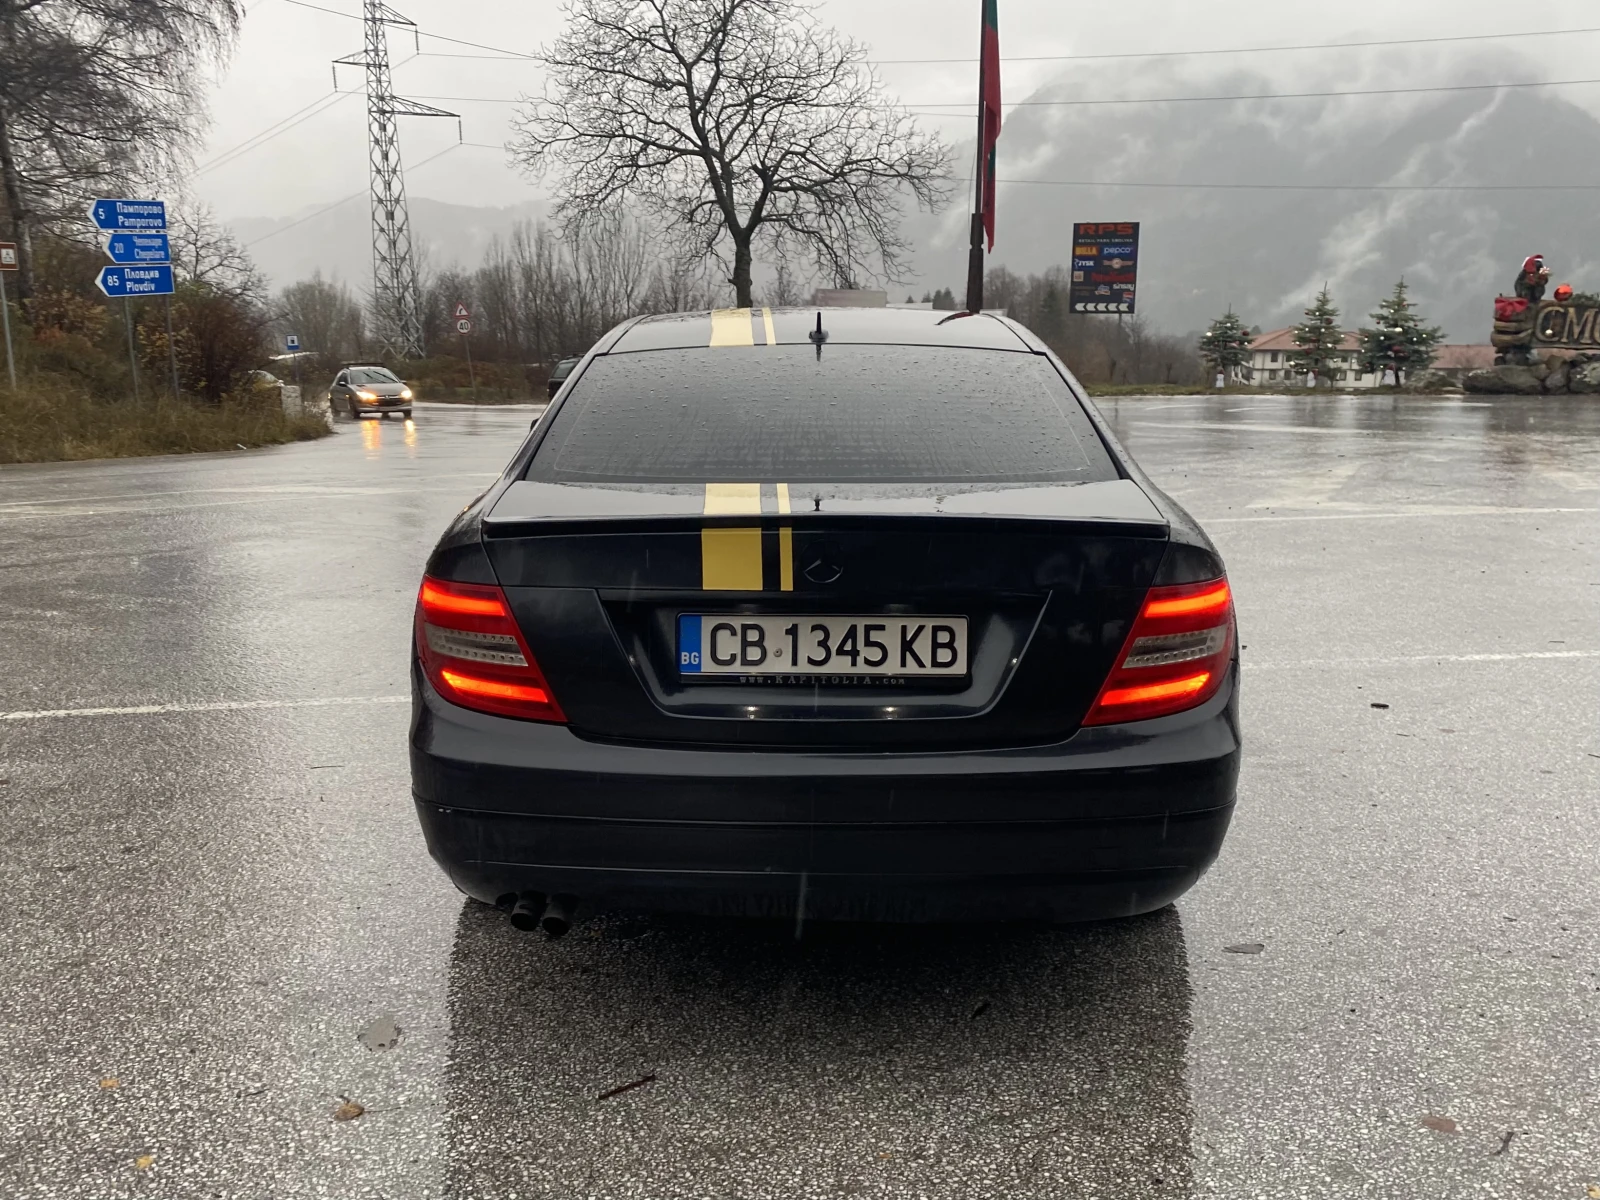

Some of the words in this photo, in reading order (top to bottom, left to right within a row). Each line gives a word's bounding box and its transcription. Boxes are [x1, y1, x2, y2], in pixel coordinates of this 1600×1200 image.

[98, 208, 105, 219] 5
[116, 202, 162, 216] Пампорово
[118, 216, 162, 228] Pamporovo
[1079, 224, 1133, 235] RPS
[114, 242, 124, 253] 20
[1103, 247, 1131, 255] pepco
[124, 269, 159, 280] Пловдив
[107, 275, 119, 286] 85
[126, 281, 155, 292] Plovdiv
[1112, 282, 1135, 291] sinsay
[459, 322, 469, 330] 40
[1535, 306, 1600, 344] СМ
[710, 622, 767, 666] CB
[785, 623, 889, 667] 1345
[899, 624, 958, 668] KB
[681, 652, 699, 665] BG
